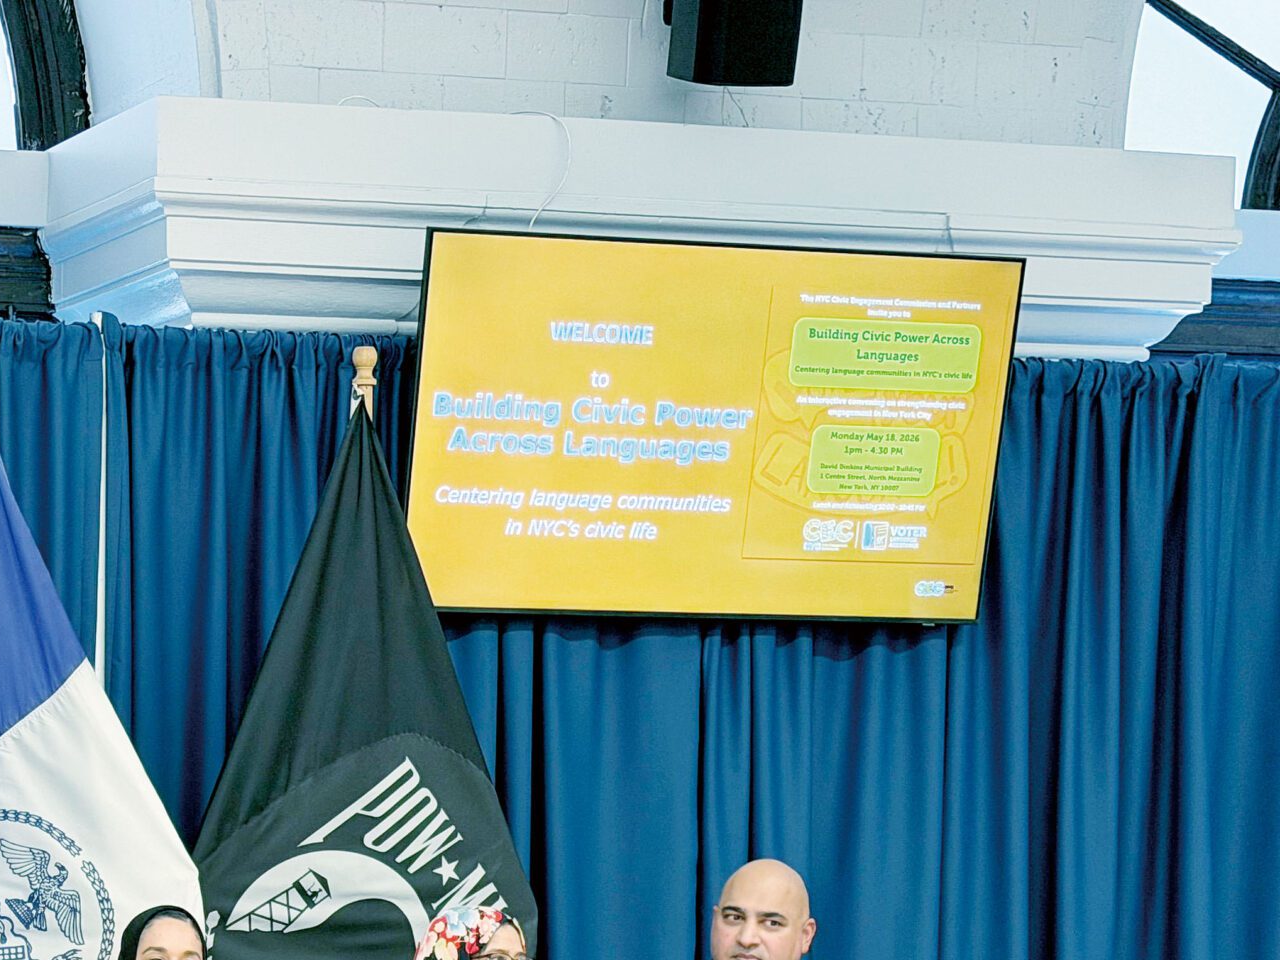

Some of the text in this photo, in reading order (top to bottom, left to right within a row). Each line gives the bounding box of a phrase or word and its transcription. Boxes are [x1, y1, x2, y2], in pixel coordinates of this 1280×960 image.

[550, 320, 654, 346] WELCOME
[808, 328, 970, 345] Building Civic Power Across
[856, 348, 919, 363] Languages
[589, 369, 610, 388] to
[794, 365, 830, 375] Centering
[832, 366, 865, 377] language
[866, 369, 912, 377] communities
[922, 370, 942, 379] NYC's
[943, 371, 960, 379] civic
[961, 372, 972, 380] life
[433, 392, 754, 430] Building Civic Power
[447, 427, 730, 466] Across Languages
[830, 431, 864, 443] Monday
[866, 433, 883, 443] May
[899, 434, 920, 442] 2026
[844, 446, 862, 456] 1pm
[890, 447, 903, 456] PM
[435, 486, 731, 513] Centering language communities
[505, 518, 658, 540] in NYC's civic life
[890, 526, 927, 537] VOTER
[297, 755, 463, 874] POW
